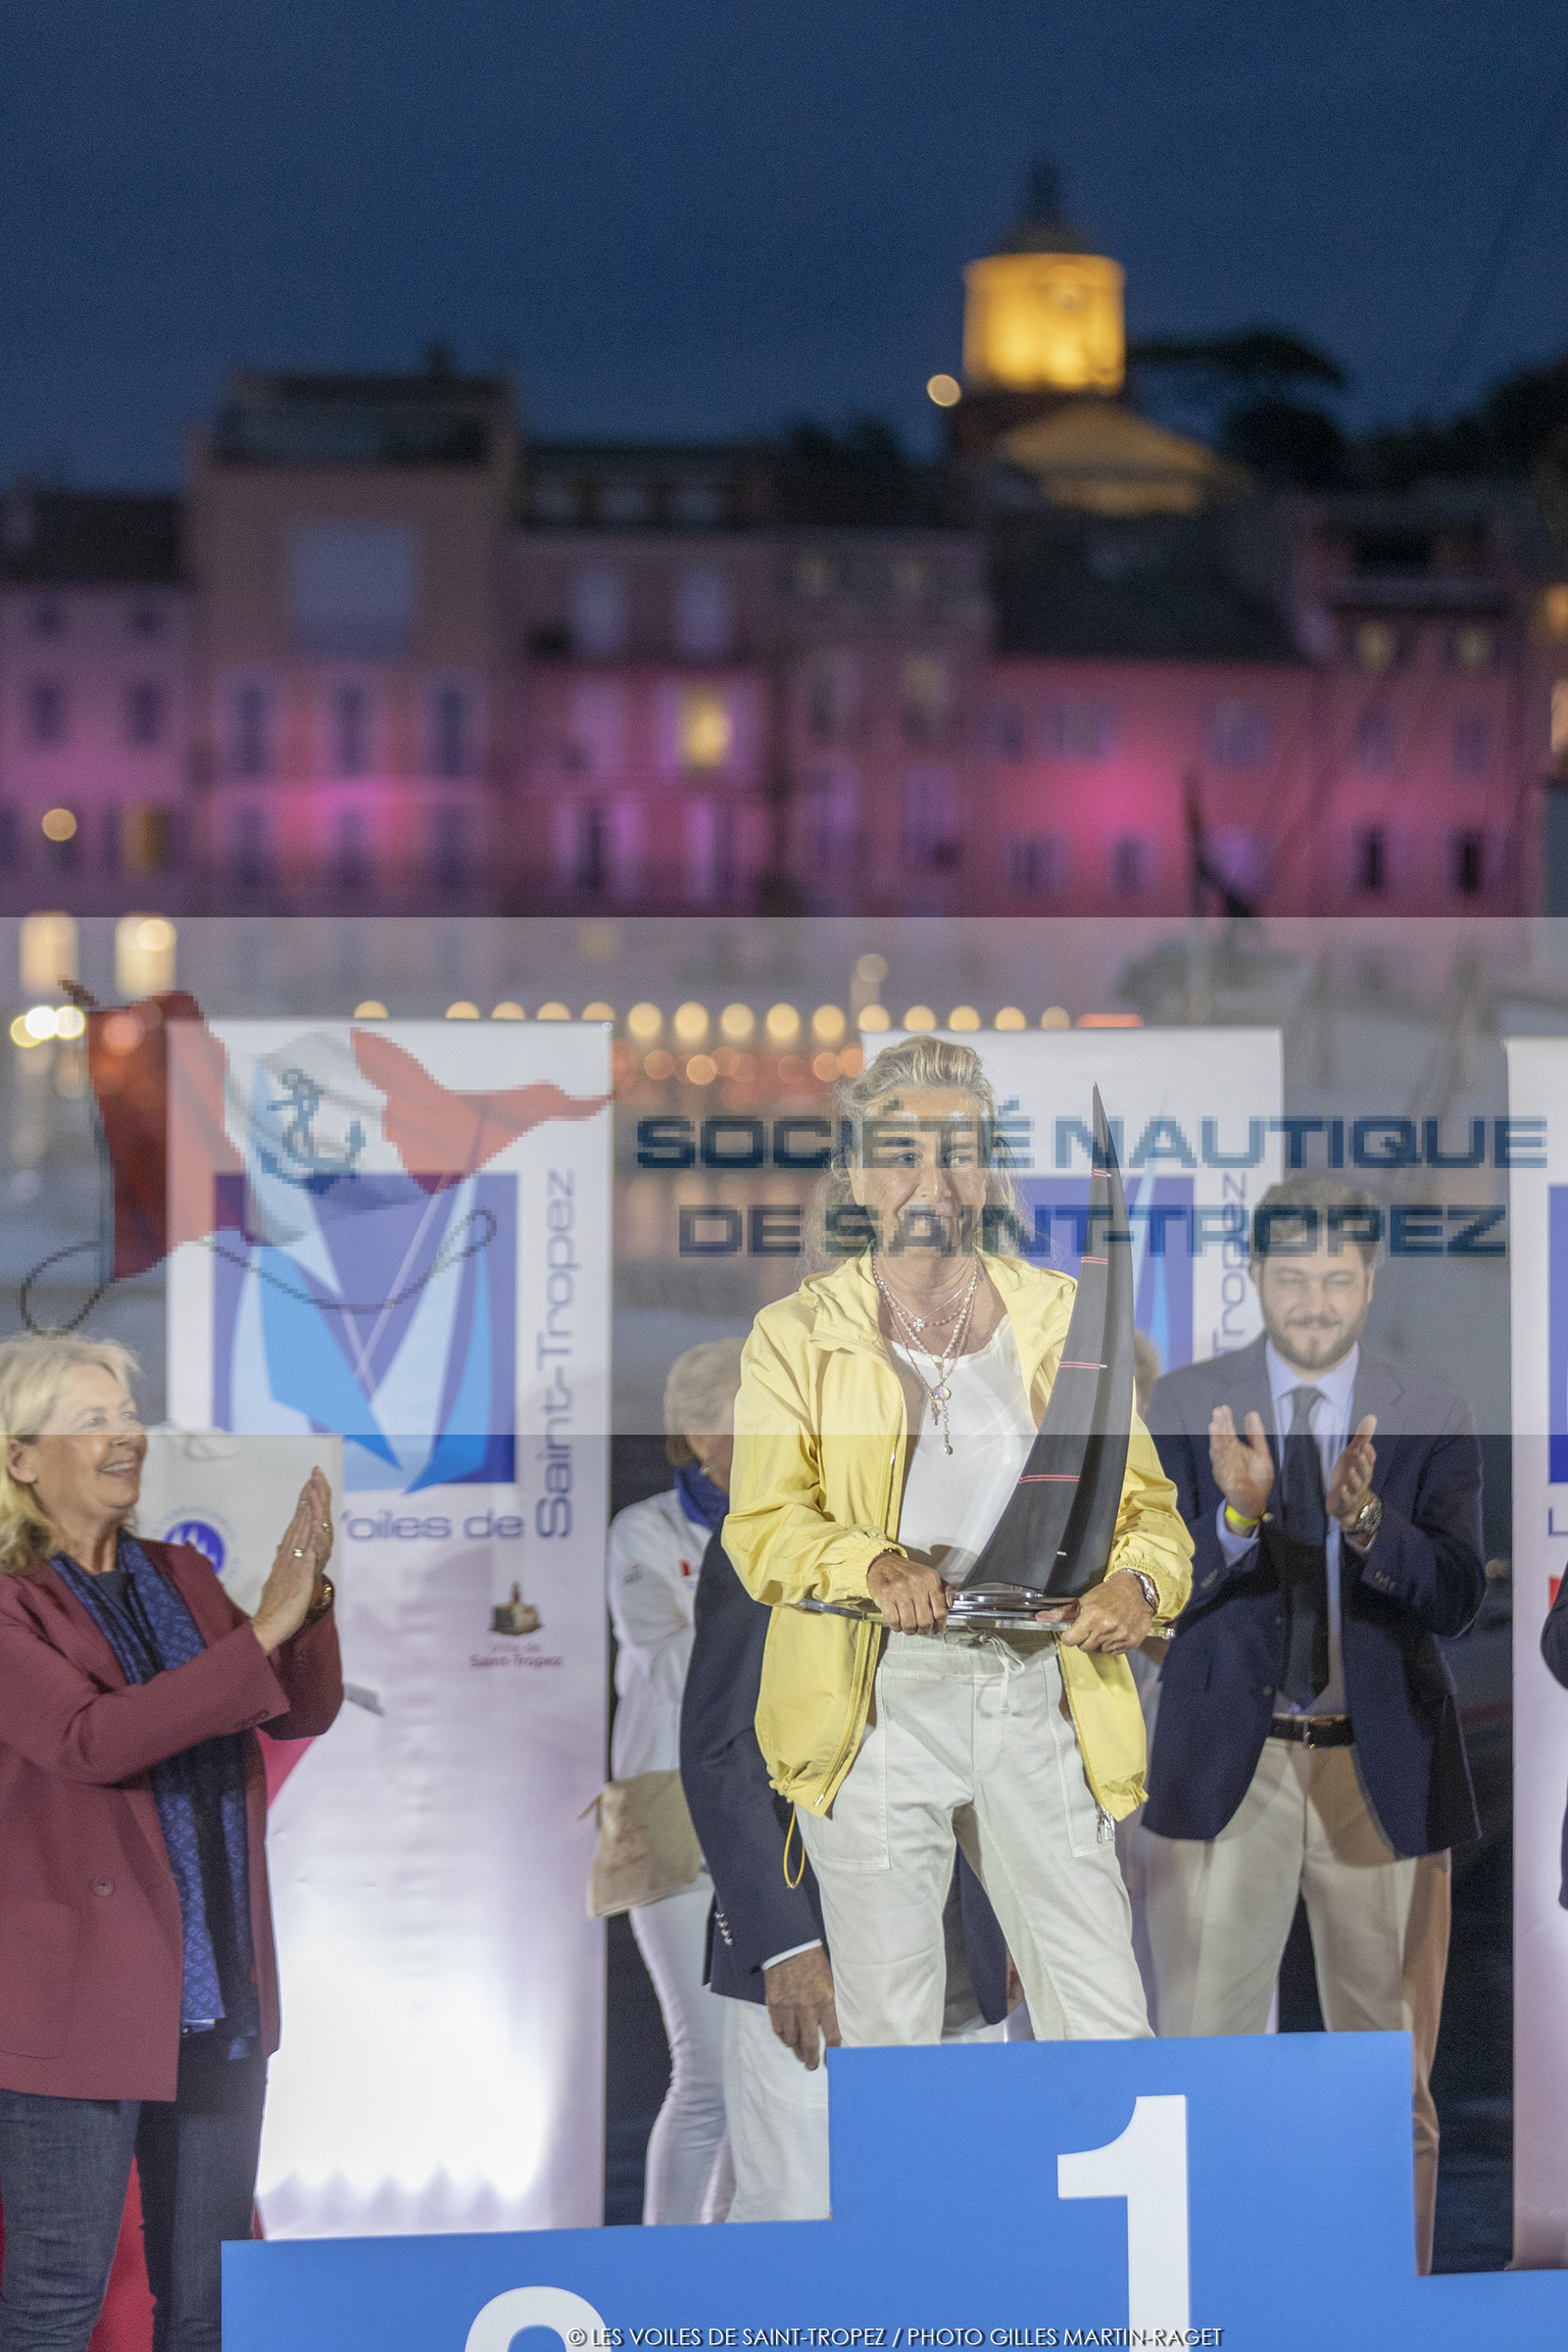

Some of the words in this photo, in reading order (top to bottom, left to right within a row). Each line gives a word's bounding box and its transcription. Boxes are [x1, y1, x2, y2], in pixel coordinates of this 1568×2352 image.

[535, 1166, 581, 1542] Saint-Tropez
[341, 1509, 453, 1541] oiles
[462, 1507, 525, 1541] de
[1057, 2094, 1190, 2352] 1
